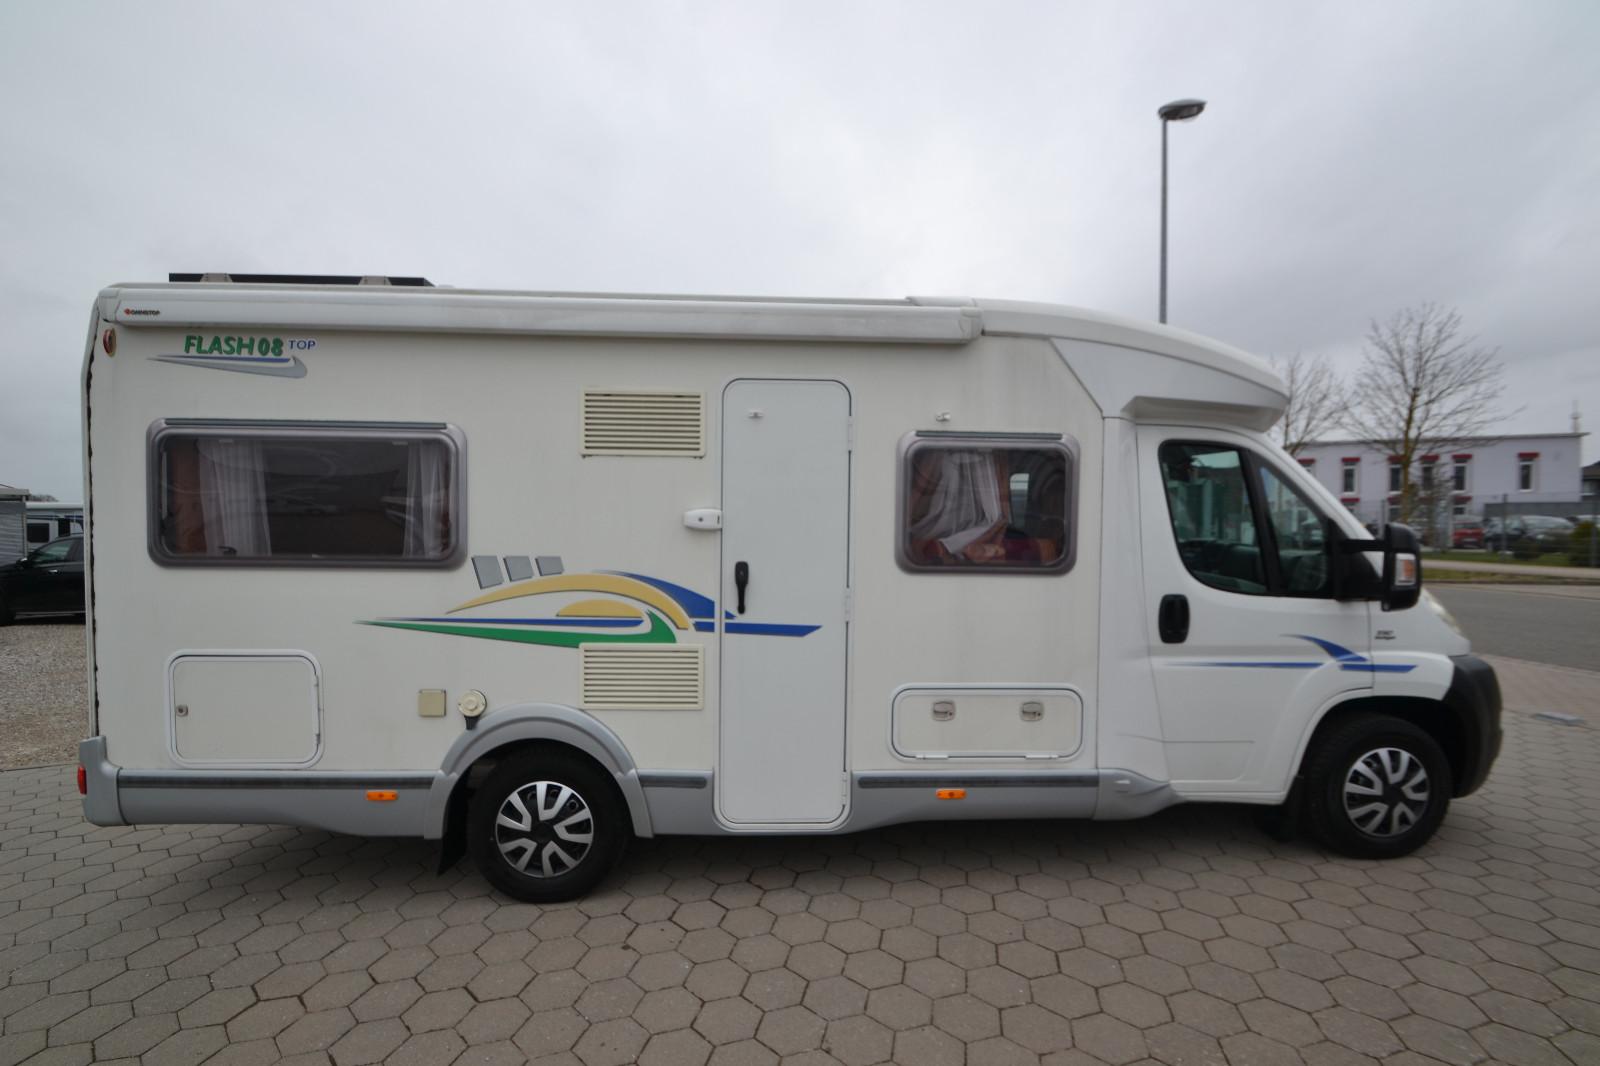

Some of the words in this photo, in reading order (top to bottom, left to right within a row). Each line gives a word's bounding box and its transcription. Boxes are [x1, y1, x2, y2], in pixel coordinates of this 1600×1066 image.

[184, 335, 255, 355] FLASH
[257, 337, 284, 357] 08
[288, 340, 316, 350] TOP
